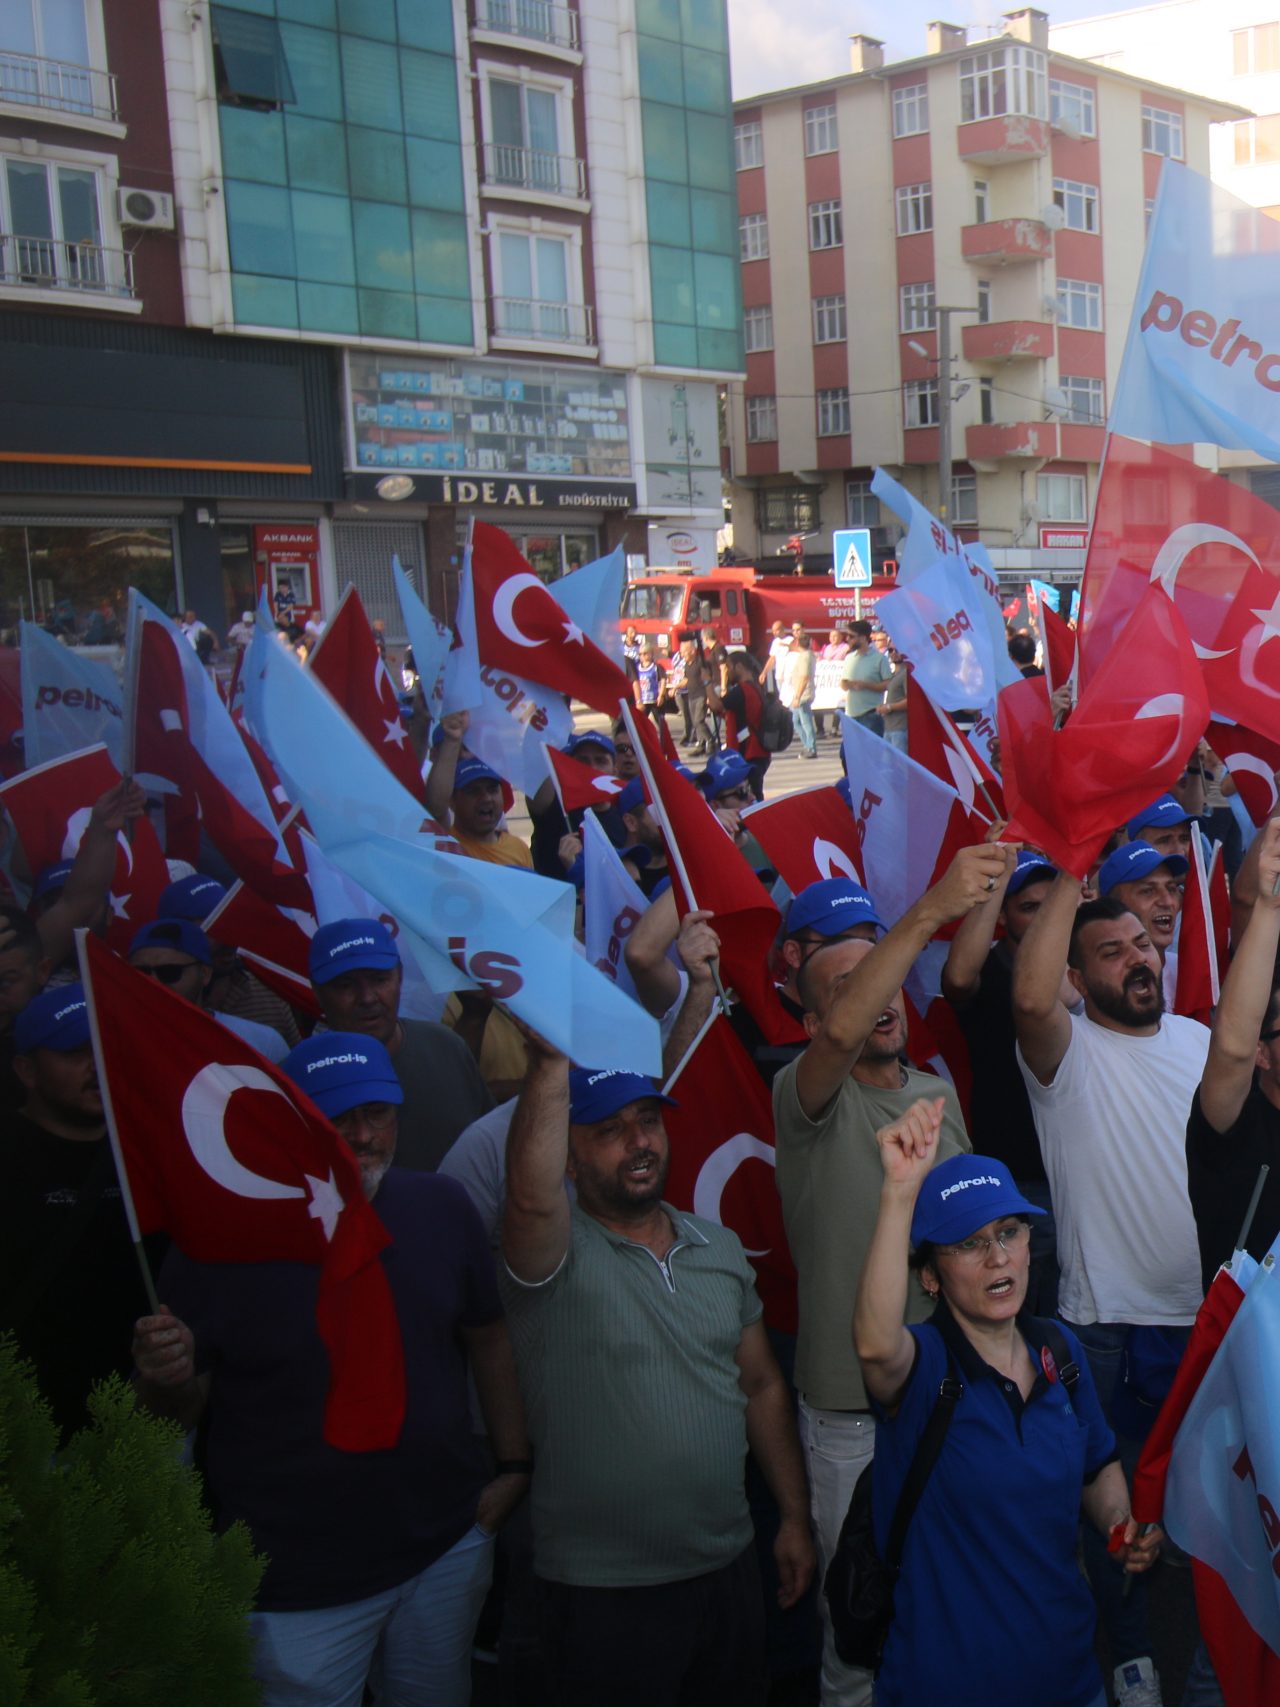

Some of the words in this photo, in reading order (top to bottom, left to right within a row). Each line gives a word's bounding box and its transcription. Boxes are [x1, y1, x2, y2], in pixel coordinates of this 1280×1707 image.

[442, 477, 544, 506] İDEAL
[559, 493, 631, 508] ENDÜSTRİYEL
[263, 533, 313, 543] AKBANK
[307, 1053, 368, 1073] petrol-iş
[941, 1175, 1001, 1201] petrol-iş
